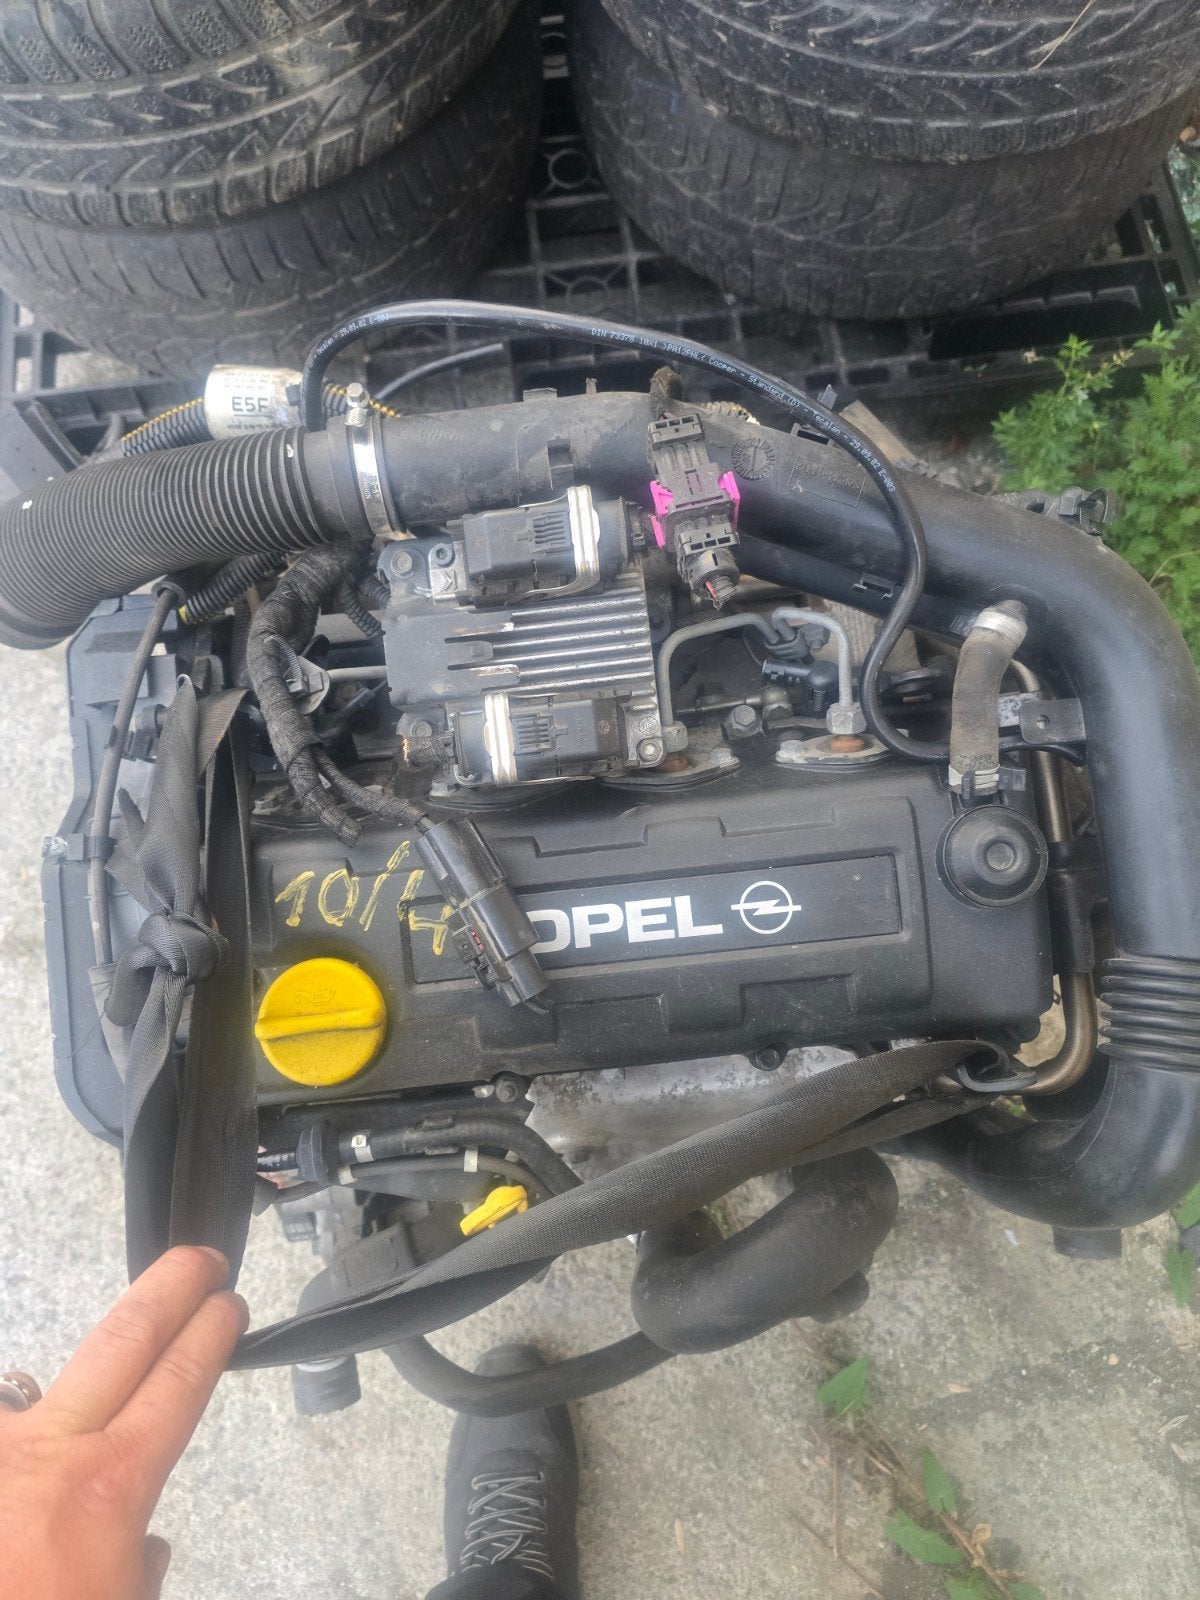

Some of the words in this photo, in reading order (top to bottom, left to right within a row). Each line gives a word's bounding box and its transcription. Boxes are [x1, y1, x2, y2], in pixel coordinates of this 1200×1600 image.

[232, 396, 269, 412] E5F
[591, 327, 607, 338] DIN
[708, 357, 737, 374] Cooper
[748, 373, 785, 400] Standard
[812, 410, 842, 435] Tecalan
[850, 439, 882, 469] 29.09.02
[526, 894, 724, 954] OPEL
